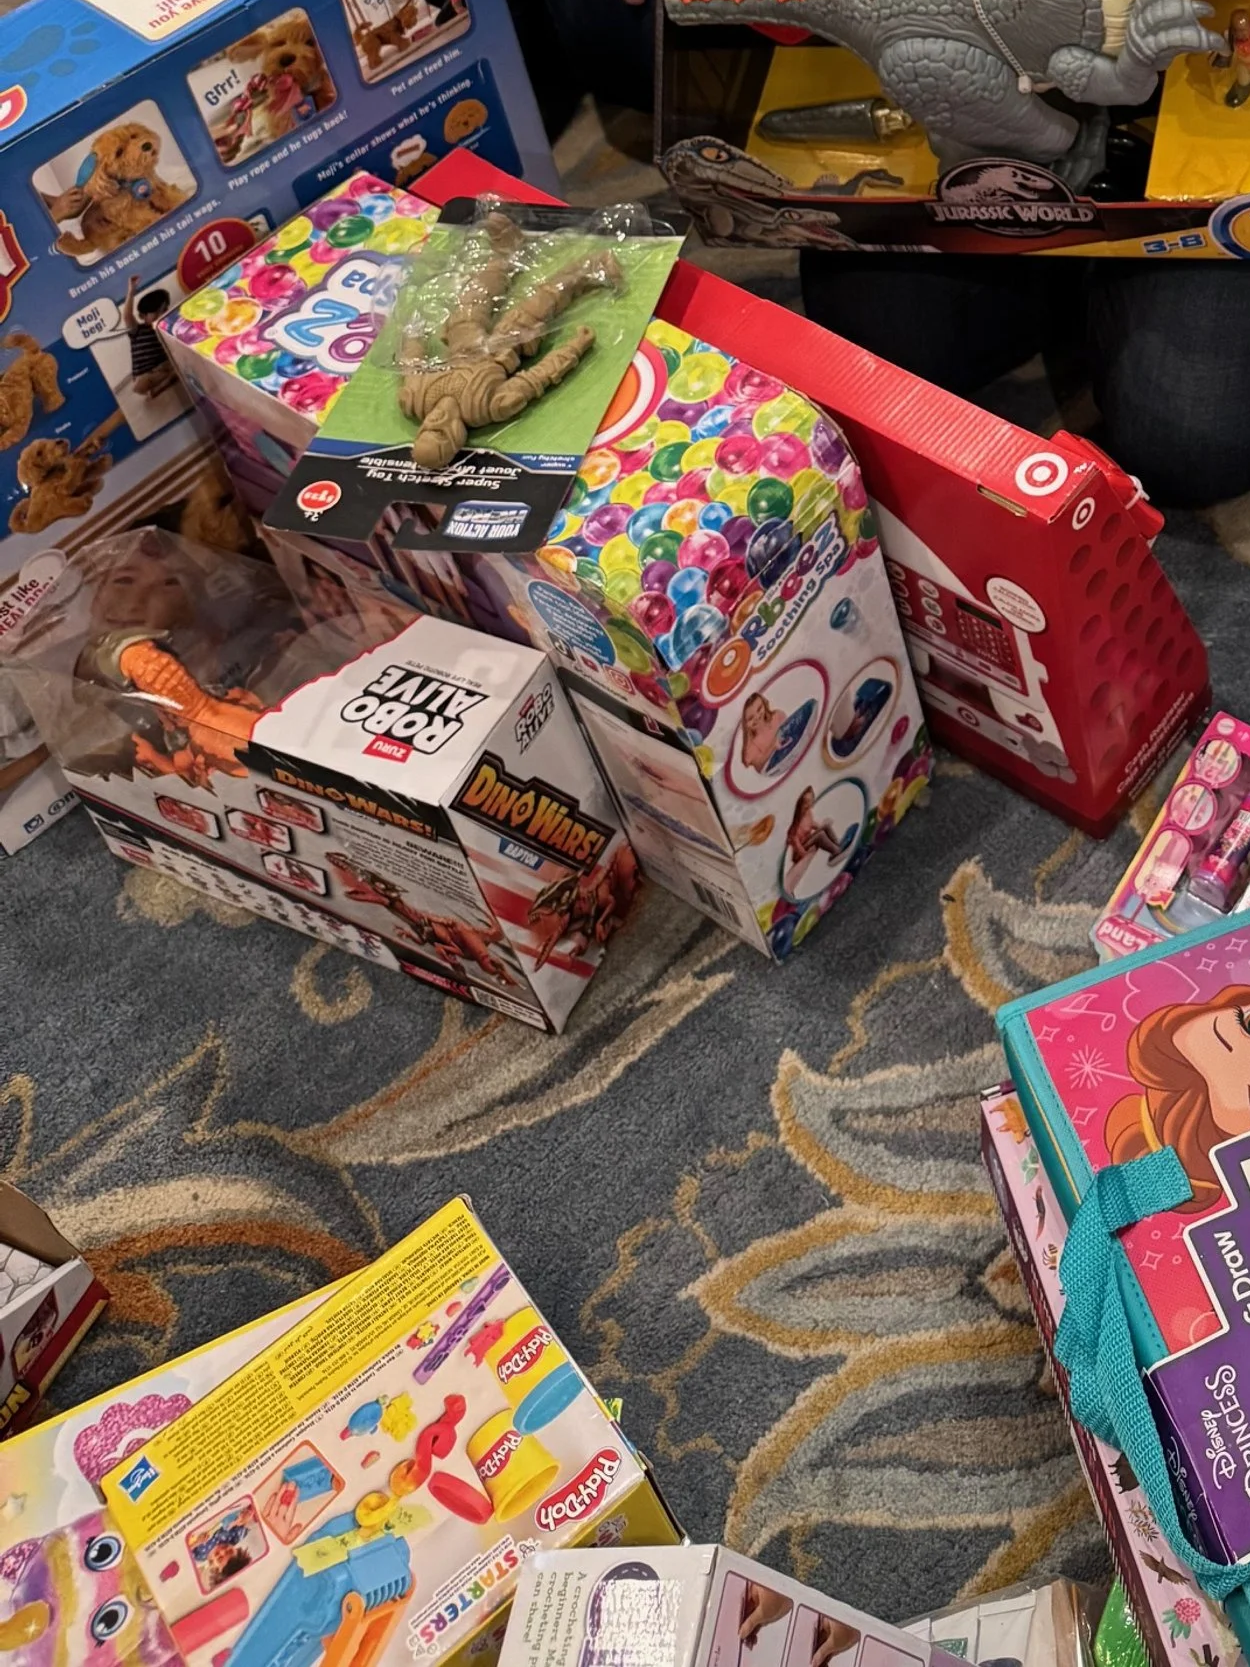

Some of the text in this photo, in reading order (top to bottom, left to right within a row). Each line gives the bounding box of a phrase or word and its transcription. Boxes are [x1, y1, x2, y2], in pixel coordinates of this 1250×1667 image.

[149, 7, 179, 28] you
[203, 69, 242, 107] Grrr!
[930, 201, 1096, 223] JURASSIC WORLD
[116, 250, 140, 271] back
[140, 237, 160, 254] and
[177, 215, 194, 232] tail
[195, 230, 227, 263] 10
[1142, 234, 1205, 254] 3-8
[77, 307, 101, 328] Moji
[82, 318, 106, 339] beg!
[757, 543, 841, 661] Soothing Spa
[371, 665, 490, 719] ALIVE
[341, 694, 464, 754] ROBO
[515, 683, 553, 737] ROBO
[518, 704, 555, 754] ALIVE
[372, 740, 406, 758] ZURU
[461, 762, 535, 828] DINO
[525, 800, 606, 865] WARS!
[504, 842, 541, 867] RAPTOR
[1101, 920, 1148, 952] Land
[538, 1452, 621, 1529] Play-Doh
[416, 1548, 524, 1647] STARTERS
[531, 1573, 544, 1598] can
